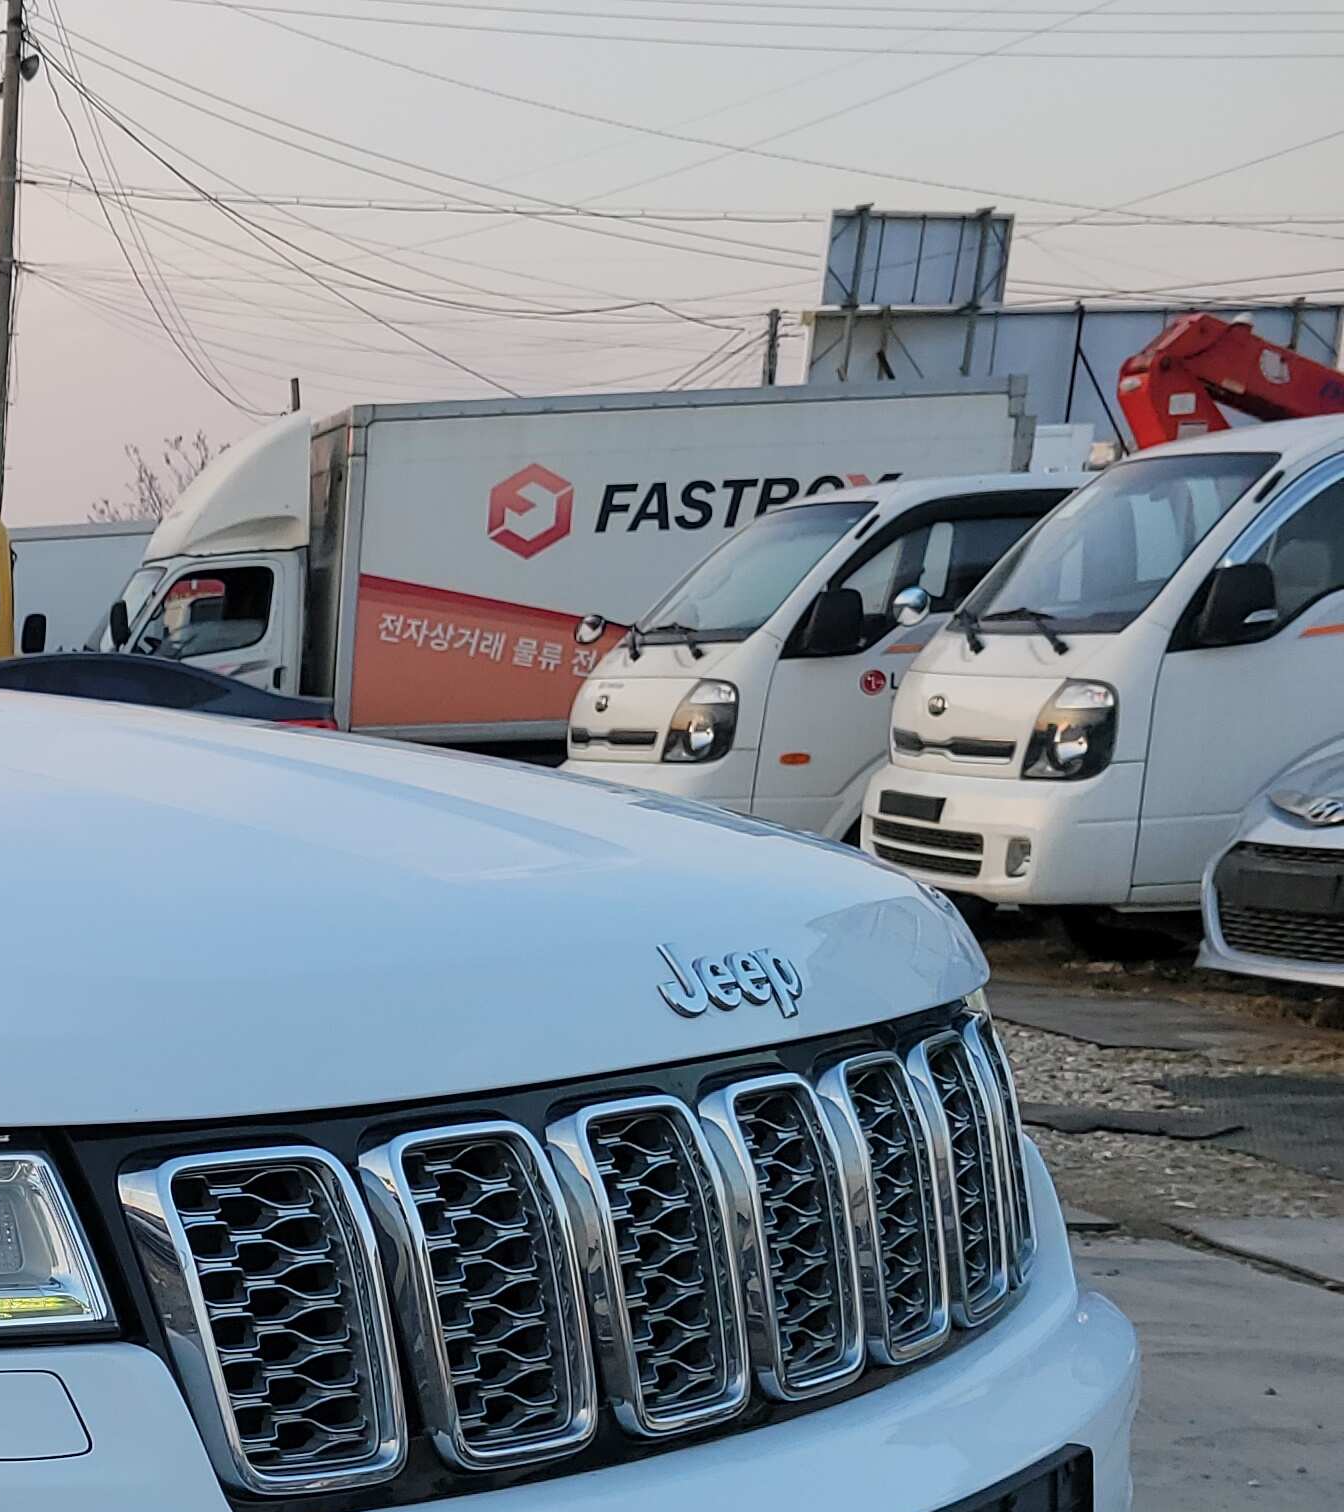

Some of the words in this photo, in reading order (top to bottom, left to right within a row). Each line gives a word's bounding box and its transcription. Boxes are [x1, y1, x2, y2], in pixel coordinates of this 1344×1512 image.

[594, 473, 903, 534] FASTB
[378, 612, 507, 663] 전자상거래
[512, 638, 563, 673] 물류
[656, 943, 803, 1019] Jeep
